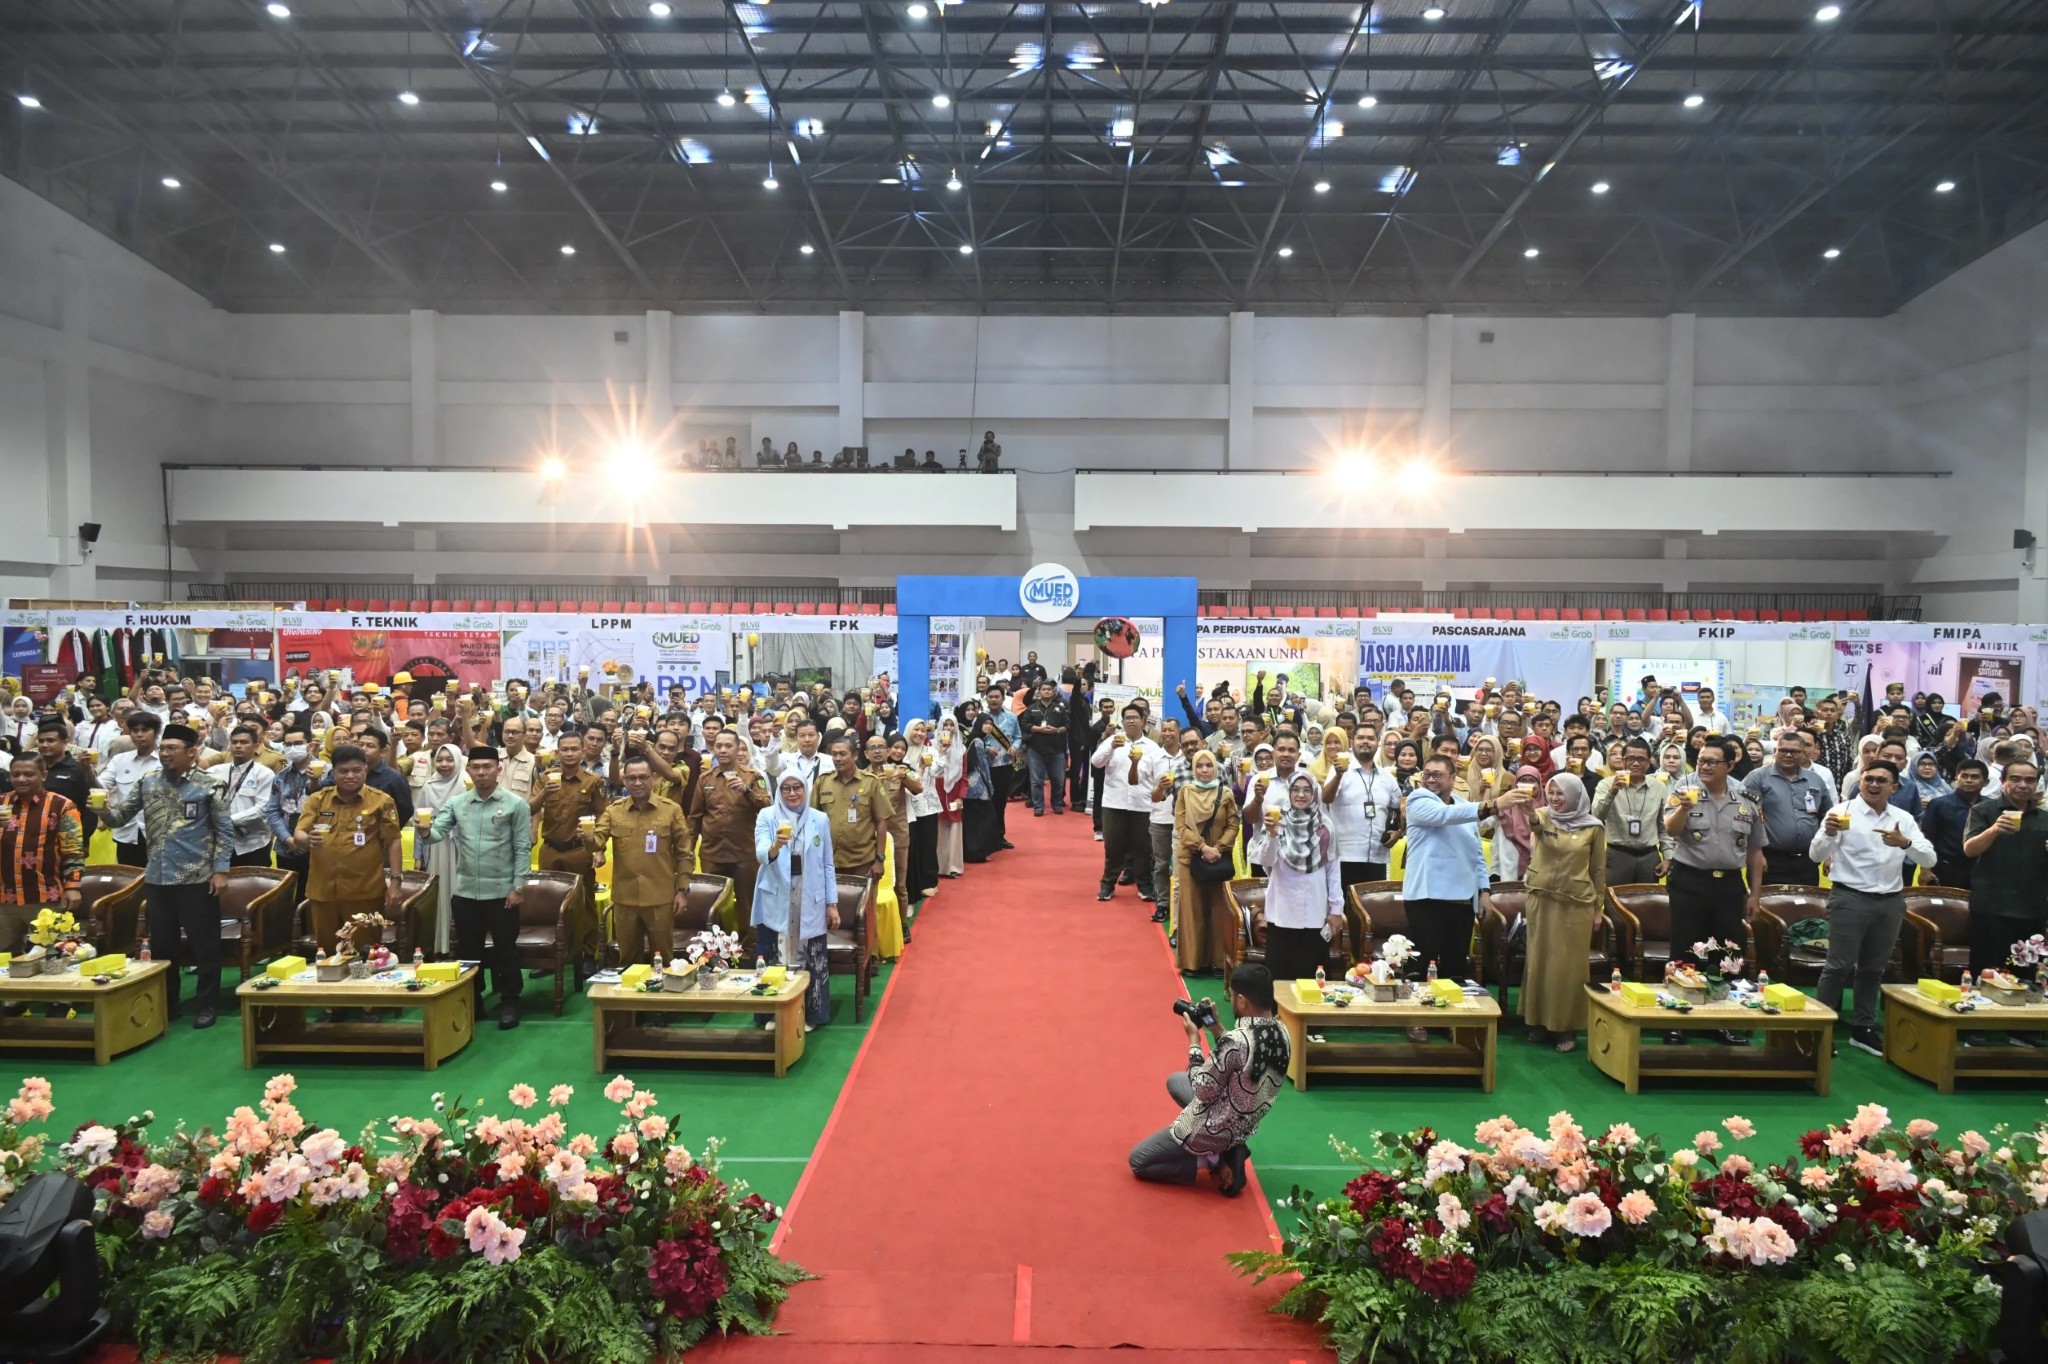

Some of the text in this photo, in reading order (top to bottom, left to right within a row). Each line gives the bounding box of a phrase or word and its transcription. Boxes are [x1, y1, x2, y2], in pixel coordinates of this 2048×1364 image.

[1032, 583, 1073, 598] MUED
[1052, 598, 1073, 607] 2026
[125, 615, 191, 626] F. HUKUM
[352, 617, 418, 628] F. TEKNIK
[473, 620, 493, 629] Grab
[591, 618, 632, 629] LPPM
[830, 620, 859, 631] FPK
[700, 622, 722, 631] Grab
[934, 622, 955, 631] Grab
[1197, 625, 1300, 634] PA PERPUSTAKAAN
[1336, 627, 1357, 636] Grab
[1432, 626, 1526, 636] PASCASARJANA
[660, 632, 700, 643] MUED
[1571, 630, 1592, 639] Grab
[1698, 627, 1735, 638] FKIP
[1810, 630, 1831, 639] Grab
[1933, 628, 1982, 639] FMIPA
[1967, 642, 2018, 652] STATISTIK
[1269, 648, 1304, 659] UNRI
